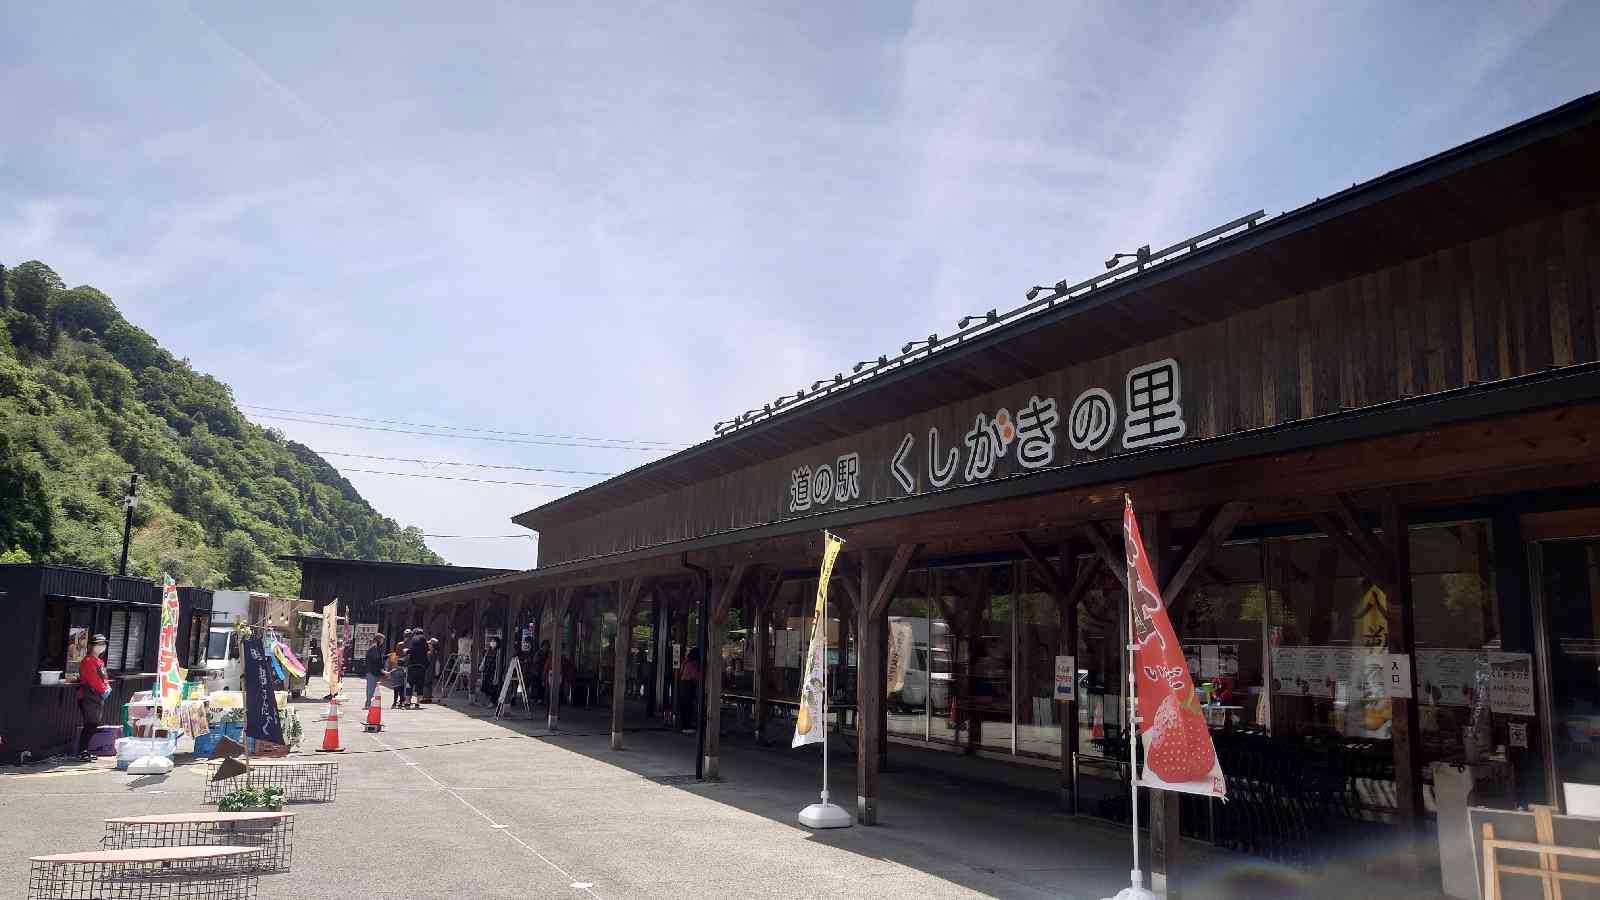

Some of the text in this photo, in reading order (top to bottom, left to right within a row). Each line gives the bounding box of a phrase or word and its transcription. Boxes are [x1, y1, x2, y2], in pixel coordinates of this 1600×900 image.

[789, 358, 1186, 512] 道の駅 くしがきの里
[1391, 661, 1400, 683] 入口
